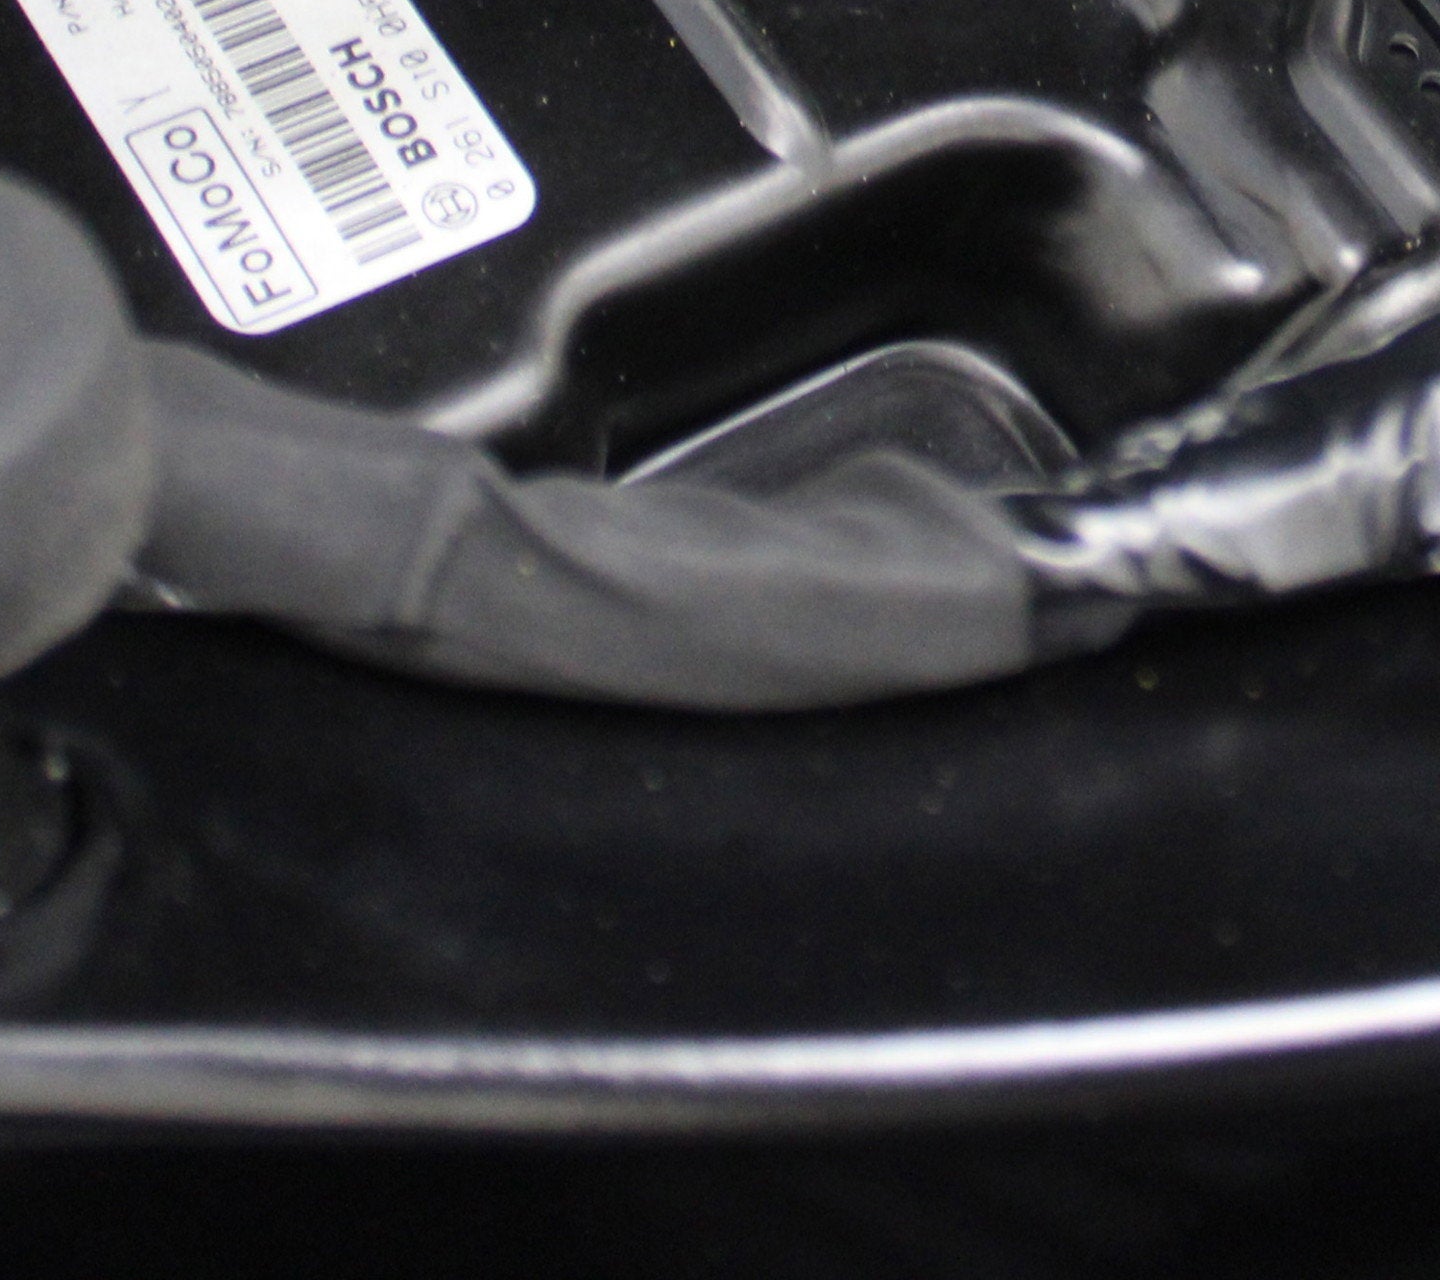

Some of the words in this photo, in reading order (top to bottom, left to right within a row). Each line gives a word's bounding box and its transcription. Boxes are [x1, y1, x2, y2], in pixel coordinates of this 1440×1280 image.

[325, 34, 440, 170] BOSCH
[441, 115, 496, 167] 261
[147, 121, 297, 308] FoMoCo
